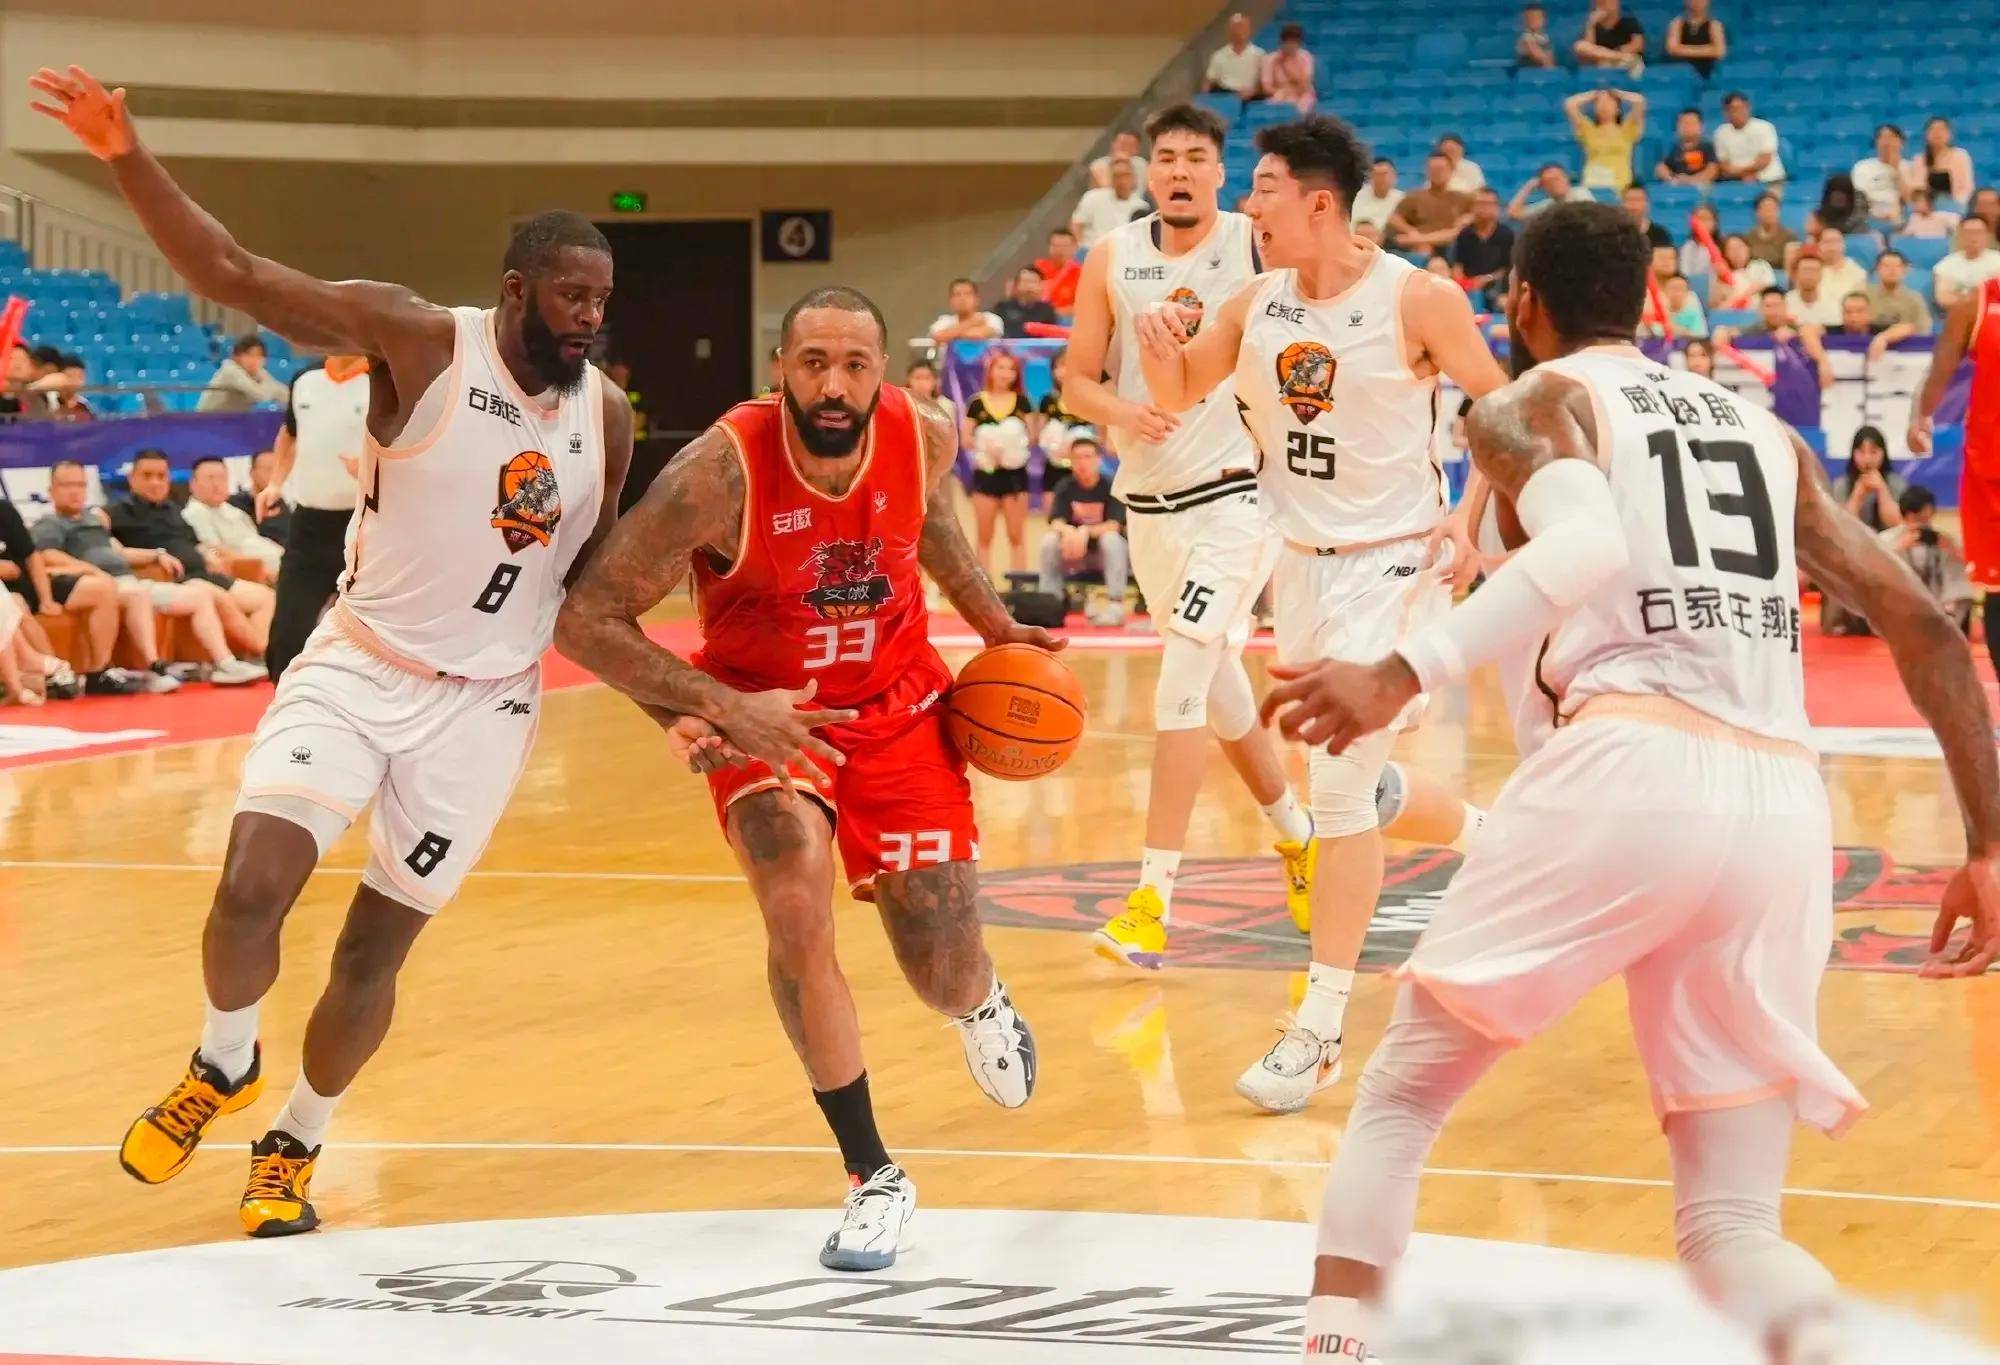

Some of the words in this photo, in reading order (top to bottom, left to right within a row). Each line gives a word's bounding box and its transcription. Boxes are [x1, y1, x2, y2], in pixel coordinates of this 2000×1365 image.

[787, 222, 807, 248] 4
[468, 386, 522, 428] 石家庄
[1286, 430, 1336, 481] 25
[1645, 428, 1780, 581] 13
[472, 562, 523, 615] 8
[1173, 579, 1216, 624] 16
[803, 617, 877, 670] 33
[964, 733, 1059, 770] SPALDING
[404, 830, 453, 878] 8
[879, 830, 951, 872] 33
[279, 1296, 606, 1321] MIDCOURT
